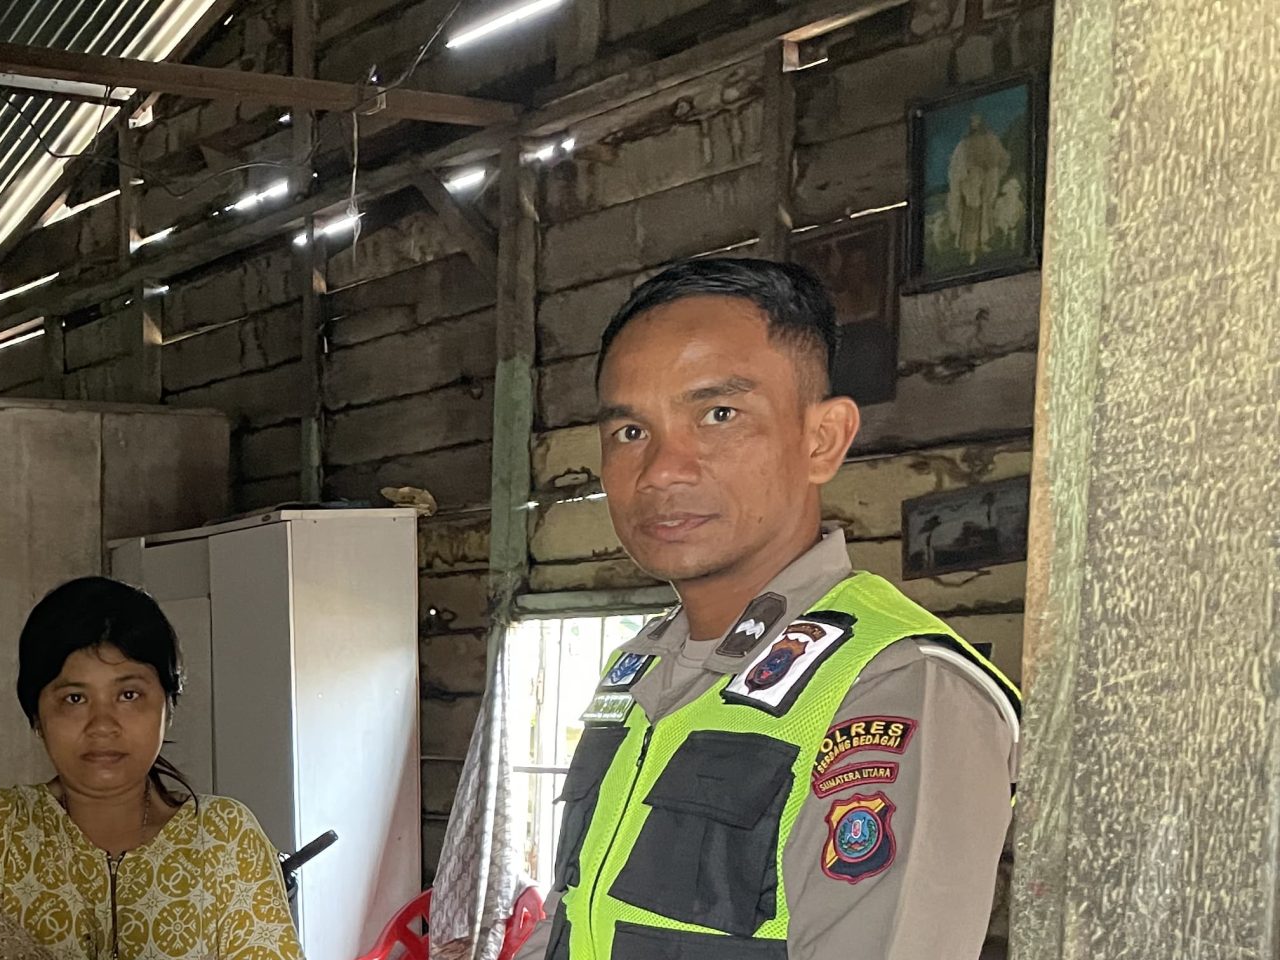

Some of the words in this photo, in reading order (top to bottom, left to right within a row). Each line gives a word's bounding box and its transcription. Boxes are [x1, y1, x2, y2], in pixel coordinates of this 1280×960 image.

[817, 721, 903, 757] OLRES
[817, 740, 851, 773] SERDANG
[852, 734, 901, 748] BEDAGAI
[819, 771, 861, 792] SUMATERA
[862, 768, 891, 778] UTARA
